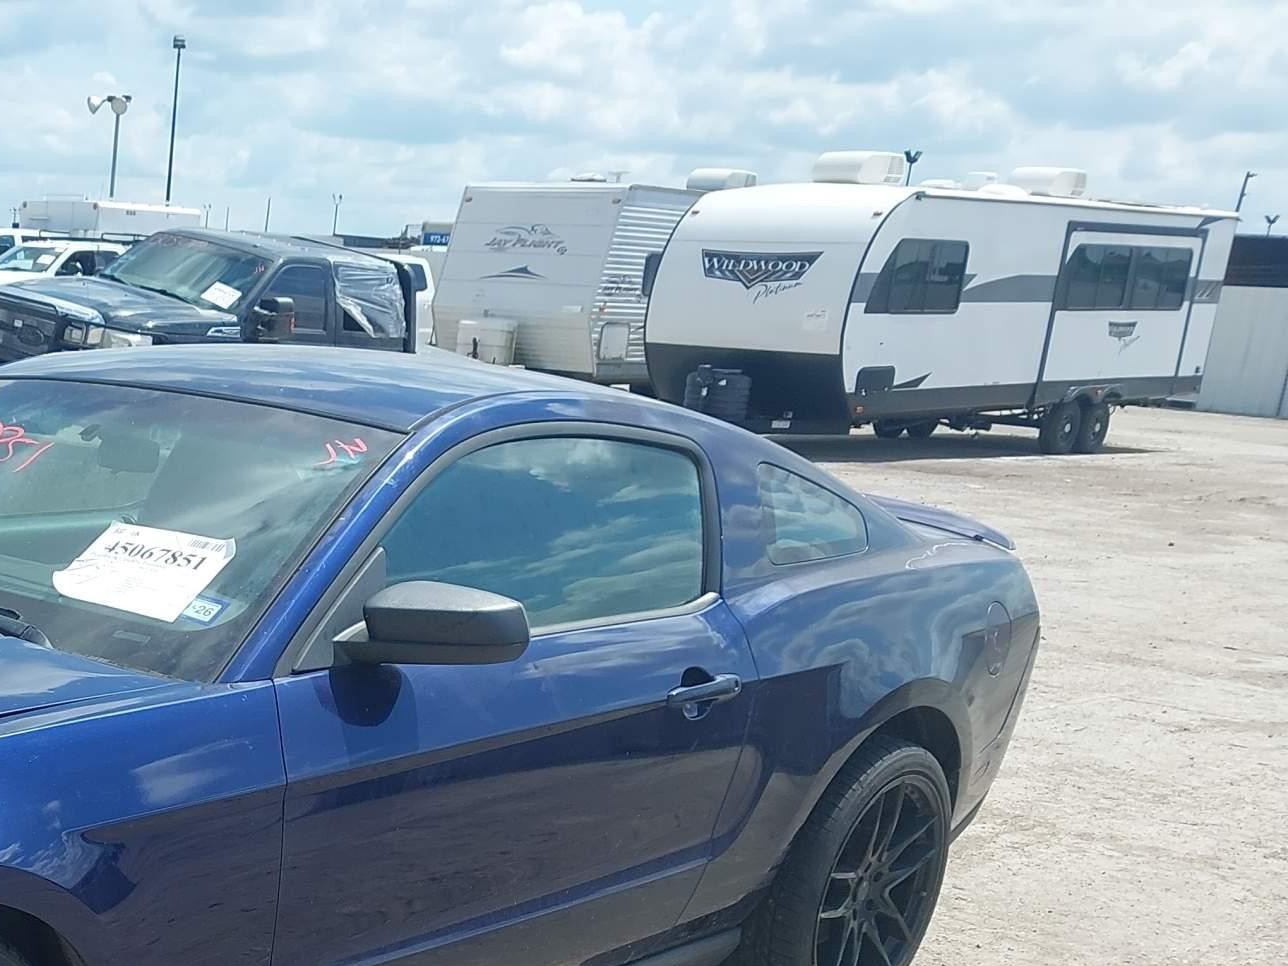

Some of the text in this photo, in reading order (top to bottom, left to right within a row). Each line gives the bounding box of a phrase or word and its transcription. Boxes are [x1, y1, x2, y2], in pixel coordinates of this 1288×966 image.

[704, 256, 810, 272] WILDWOOD
[752, 281, 803, 304] Platinum
[104, 540, 208, 571] 45067851
